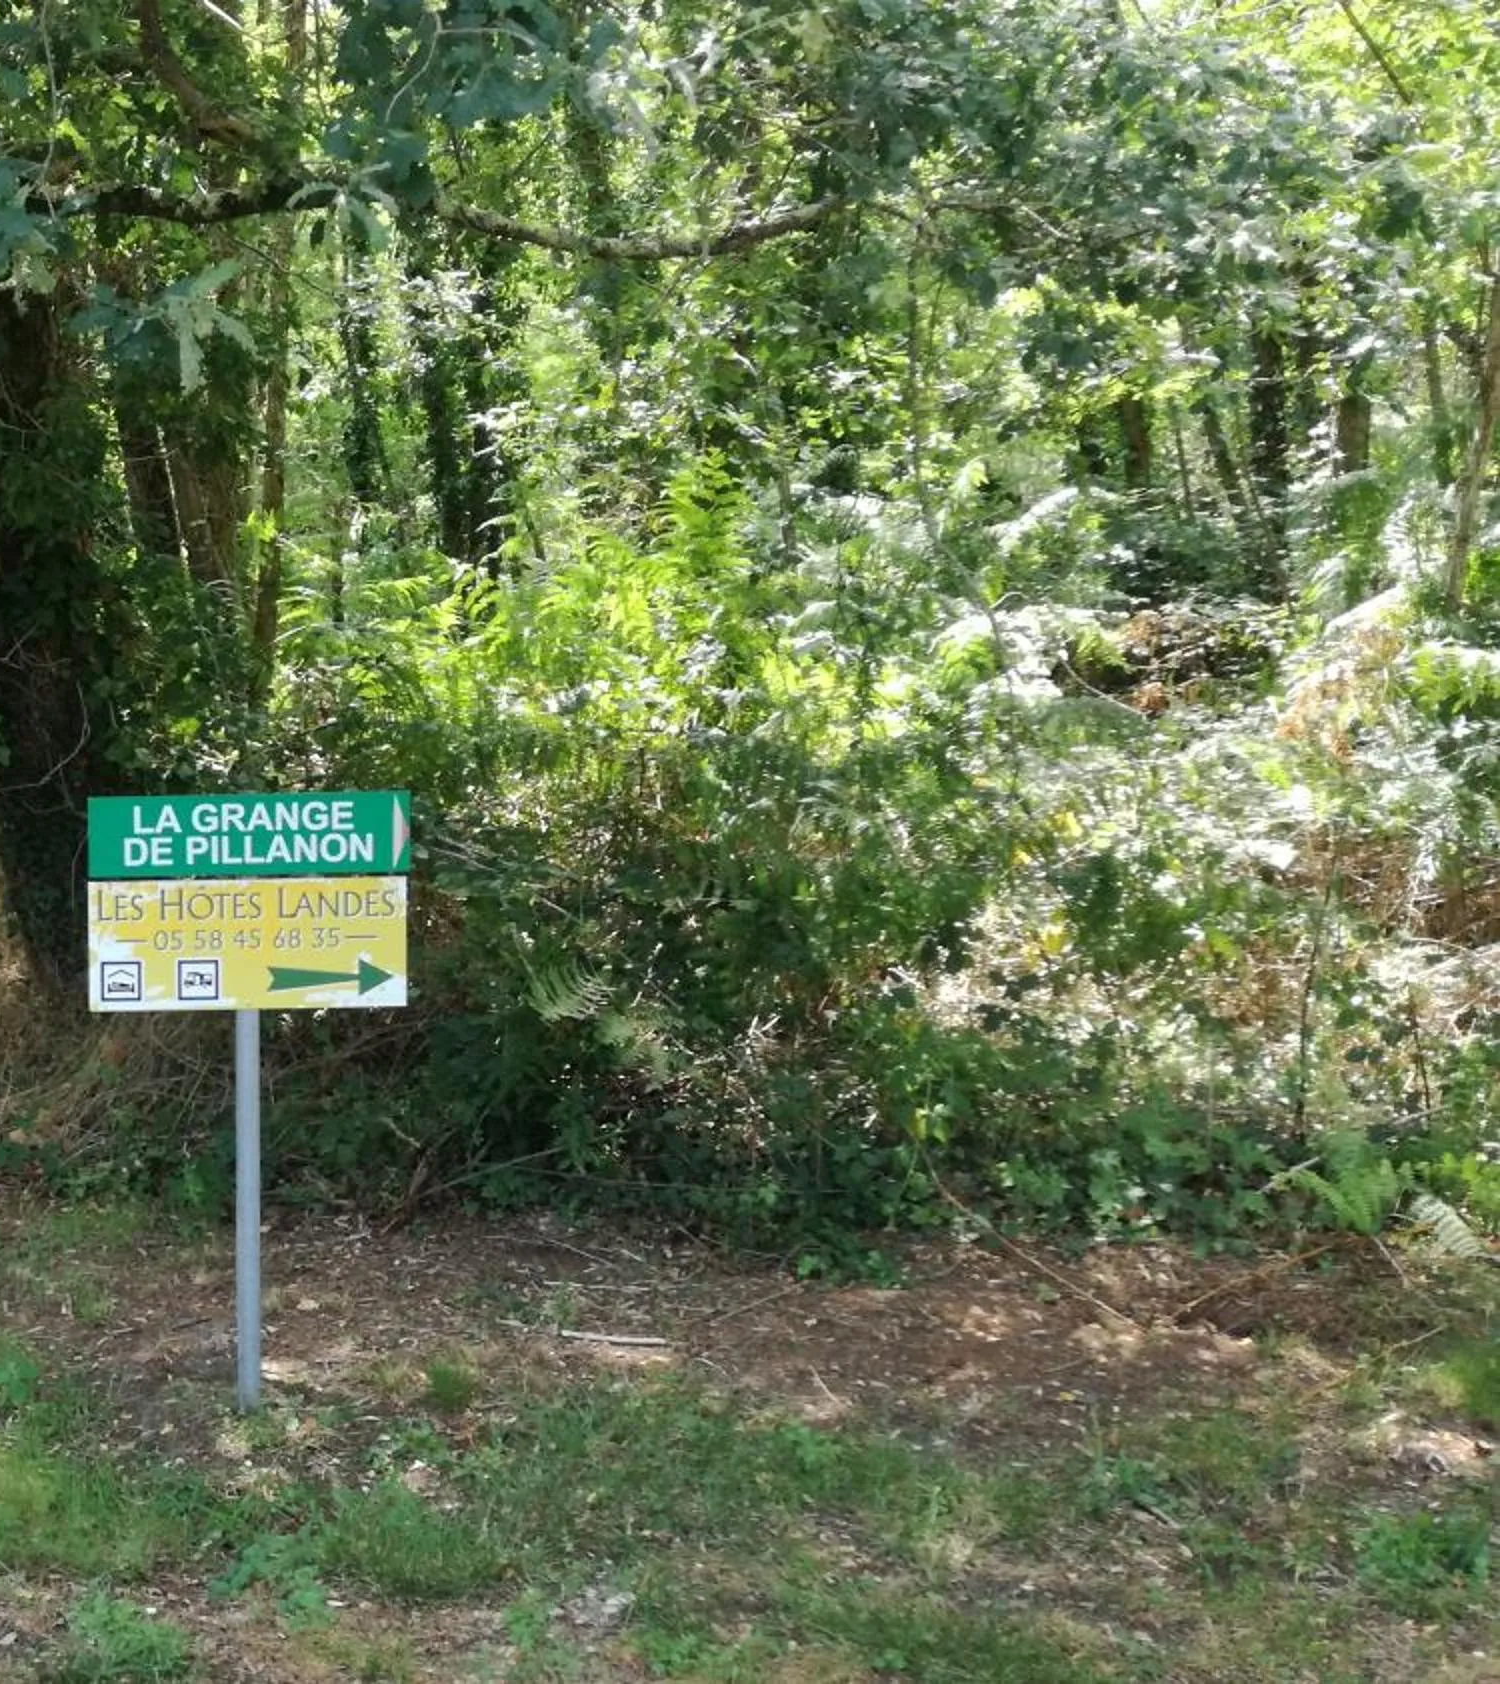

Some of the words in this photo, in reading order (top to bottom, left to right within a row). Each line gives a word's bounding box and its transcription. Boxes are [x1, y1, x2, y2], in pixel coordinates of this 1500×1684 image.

[132, 805, 182, 835] LA
[192, 801, 354, 833] GRANGE
[123, 837, 174, 867] DE
[185, 833, 375, 865] PILLANON
[98, 889, 144, 922] LES
[277, 887, 395, 919] LANDES
[154, 930, 183, 951] 05
[194, 929, 223, 950] 58
[233, 928, 261, 949] 45
[274, 928, 301, 949] 68
[312, 927, 341, 948] 35
